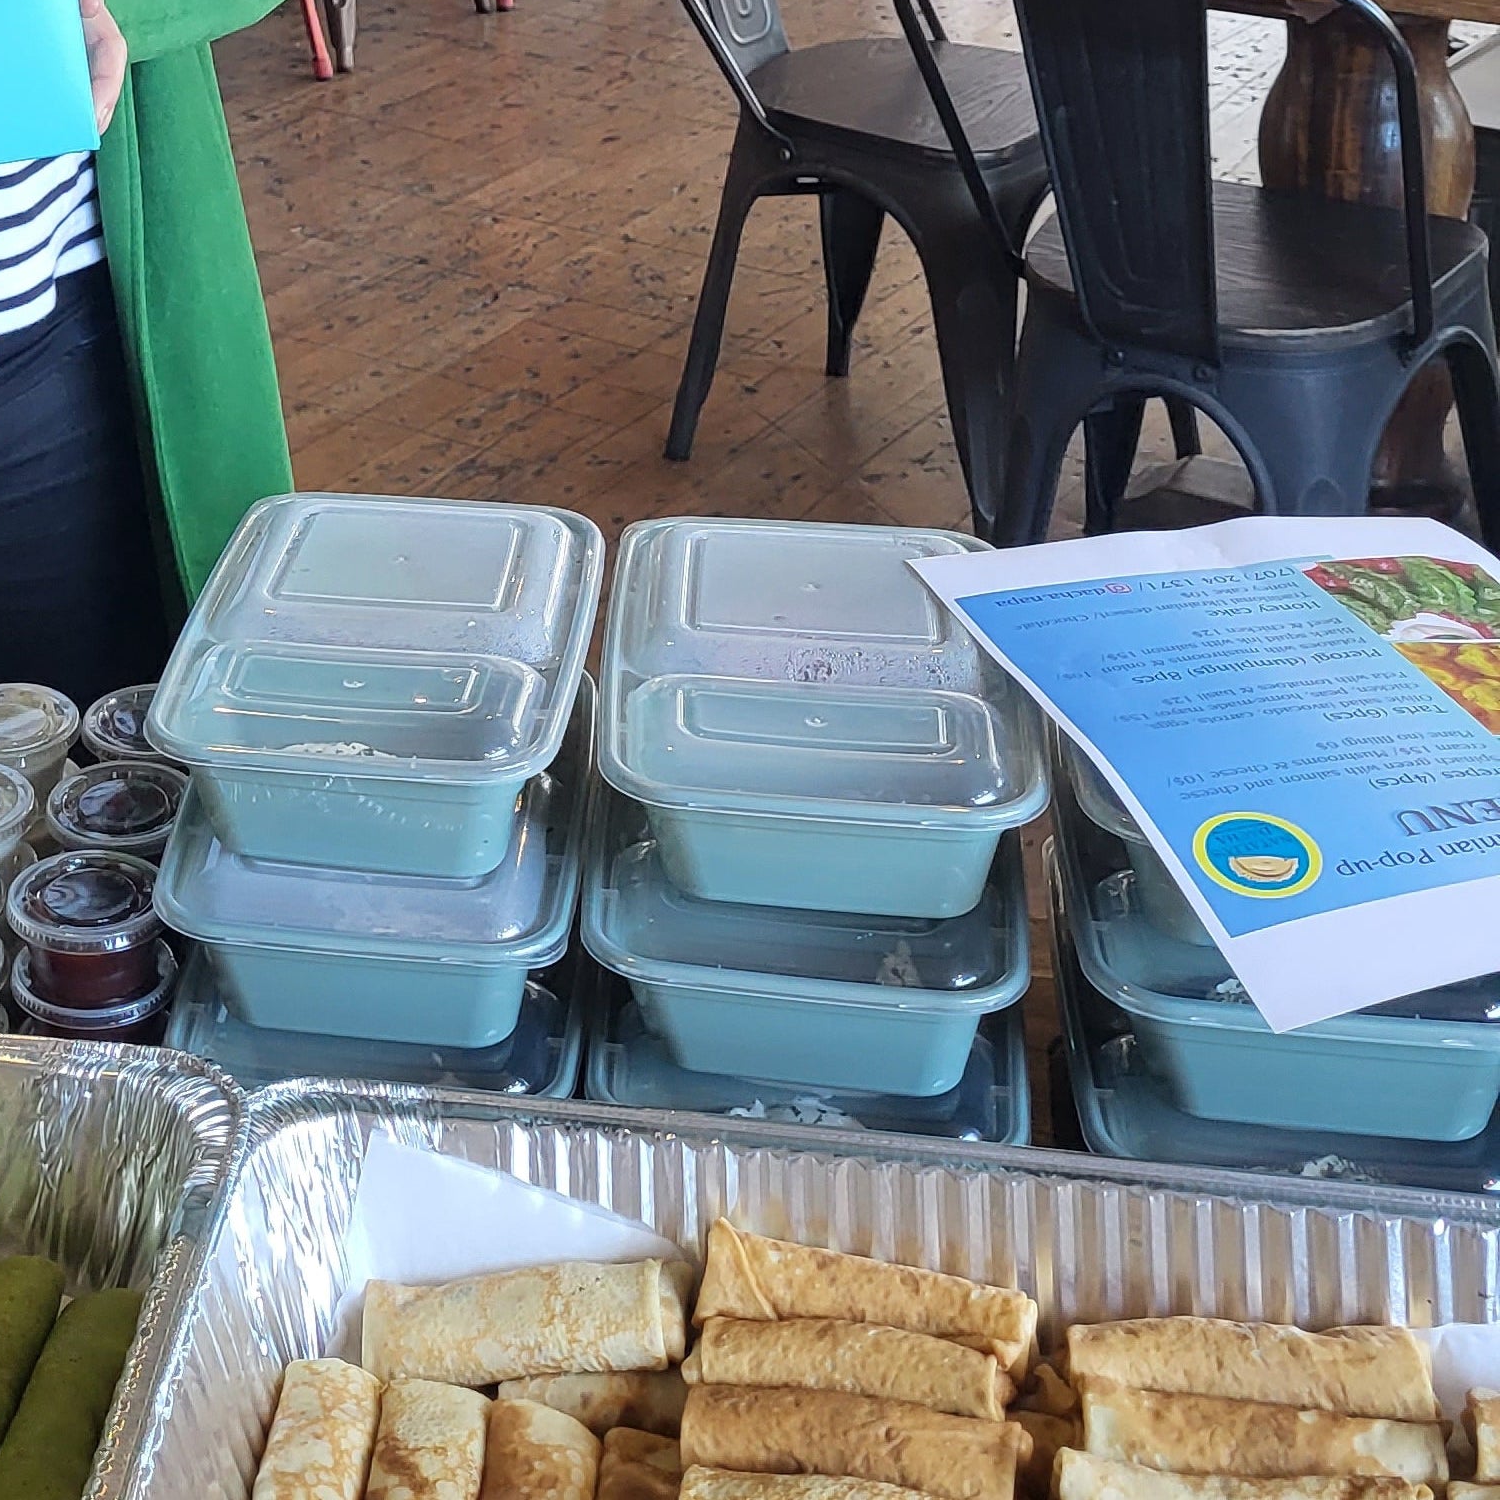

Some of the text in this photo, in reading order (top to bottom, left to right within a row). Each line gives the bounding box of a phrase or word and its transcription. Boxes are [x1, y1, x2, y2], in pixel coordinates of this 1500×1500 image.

[1202, 574, 1240, 586] 204
[1244, 567, 1295, 581] (707)
[1212, 586, 1249, 596] cake
[1252, 580, 1299, 593] honey
[1231, 591, 1311, 605] Traditional
[1156, 598, 1228, 612] Ukrainian
[1205, 600, 1321, 618] Honey cake
[1013, 614, 1089, 632] Chocolate
[1289, 621, 1302, 630] &
[1306, 616, 1342, 628] Beef
[1227, 623, 1284, 635] chicken
[1309, 626, 1354, 638] Black
[1201, 638, 1232, 649] with
[1237, 636, 1262, 645] ink
[1265, 632, 1307, 643] squid
[1300, 636, 1366, 651] Potatoes
[1140, 642, 1197, 656] salmon
[1264, 646, 1297, 656] with
[1169, 647, 1259, 665] mushrooms
[1101, 660, 1146, 674] onion
[1132, 648, 1382, 685] Pierogi (dumplings) 8pcs
[1150, 659, 1164, 668] &
[1334, 674, 1368, 684] with
[1372, 671, 1407, 680] Feta
[1239, 686, 1253, 695] &
[1257, 678, 1332, 691] tomatoes
[1196, 688, 1236, 701] basil
[1387, 693, 1432, 704] Olivie
[1339, 697, 1382, 709] salad
[1323, 704, 1448, 723] Tarts (6pcs)
[1341, 734, 1394, 747] filling)
[1397, 731, 1424, 742] (no
[1427, 729, 1474, 739] Plane
[1435, 742, 1486, 752] cream
[1274, 761, 1288, 770] &
[1292, 750, 1388, 768] Mushrooms
[1383, 757, 1431, 769] green
[1210, 764, 1269, 779] cheese
[1344, 763, 1379, 775] with
[1279, 769, 1340, 784] salmon
[1368, 767, 1500, 790] repes (4pcs)
[1243, 778, 1275, 791] and
[1179, 785, 1239, 801] cheese
[1396, 798, 1500, 836] ENU
[1335, 834, 1500, 876] nian Pop-up
